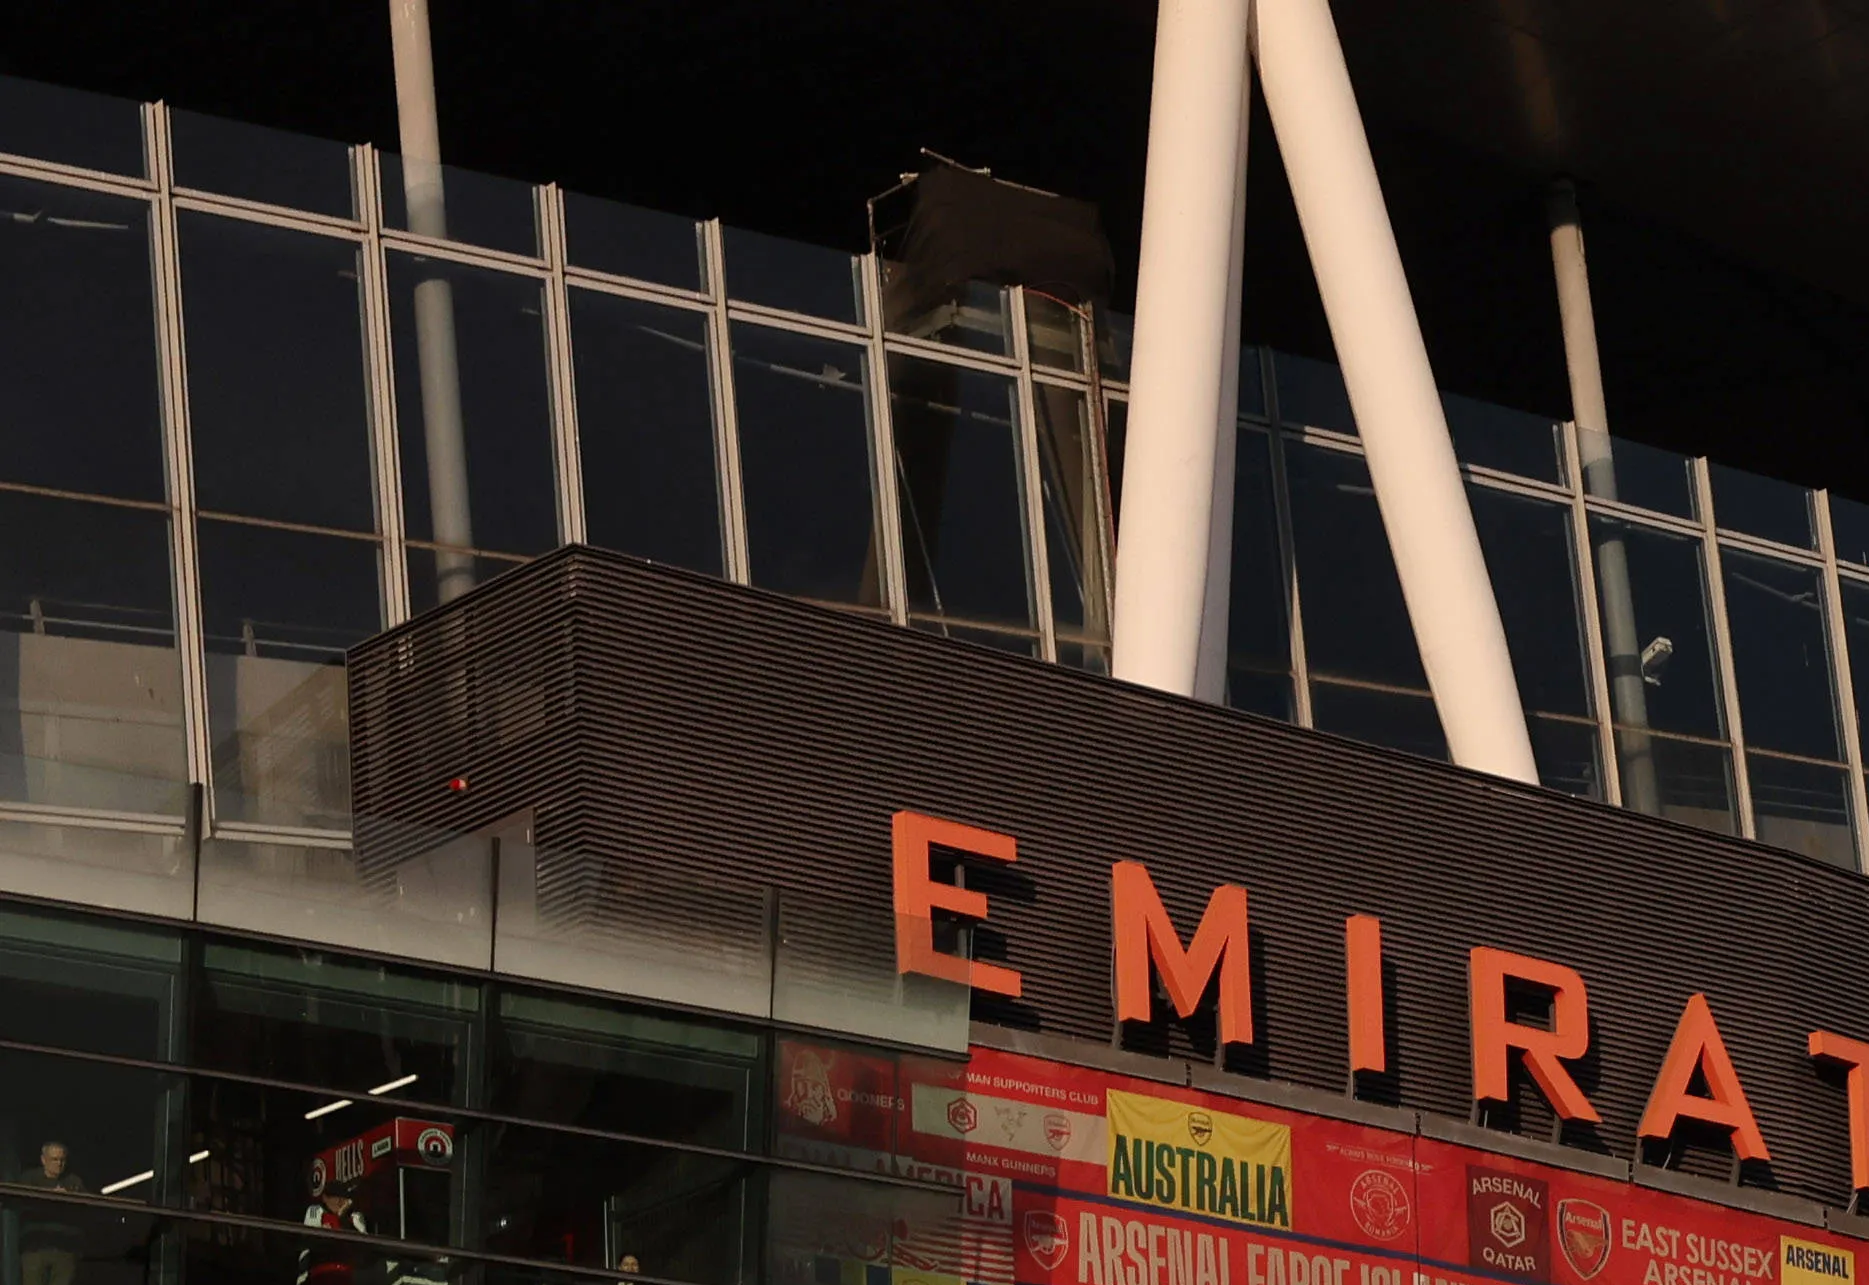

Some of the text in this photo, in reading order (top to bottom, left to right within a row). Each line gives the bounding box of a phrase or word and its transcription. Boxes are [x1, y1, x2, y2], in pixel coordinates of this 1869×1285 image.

[993, 1076, 1098, 1105] SUPPORTERS CLUB
[1001, 1159, 1056, 1177] GUNNERS
[1110, 1134, 1290, 1229] AUSTRALIA
[1472, 1176, 1542, 1209] ARSENAL
[1482, 1247, 1536, 1272] QATAR
[1621, 1219, 1775, 1280] EAST SUSSEX
[1786, 1241, 1850, 1279] ARSENAL
